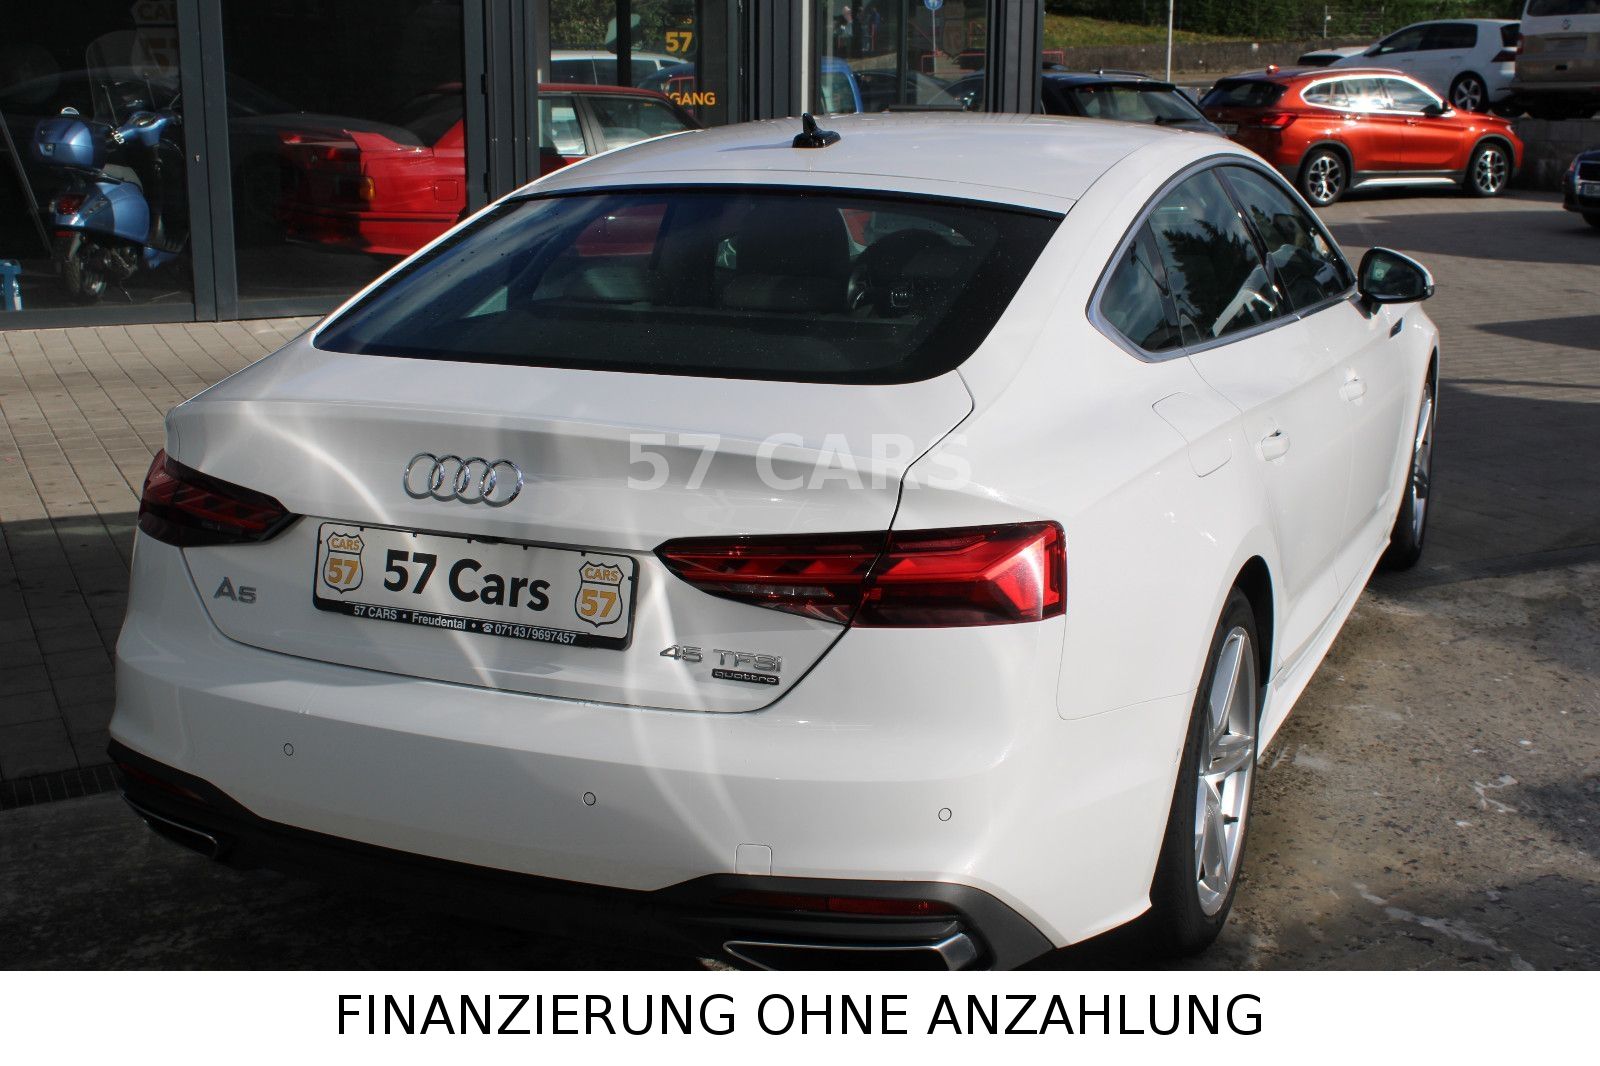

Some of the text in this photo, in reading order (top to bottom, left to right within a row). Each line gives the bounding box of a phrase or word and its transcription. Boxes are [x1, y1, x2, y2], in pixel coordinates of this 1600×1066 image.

[665, 31, 693, 52] 57
[331, 538, 360, 551] CARS
[327, 557, 358, 585] 57
[384, 549, 551, 612] 57 Cars
[584, 567, 619, 582] CARS
[213, 576, 257, 604] A5
[580, 588, 617, 618] 57
[354, 605, 366, 616] 57
[368, 607, 398, 620] CARS
[412, 612, 466, 630] Freudental
[659, 644, 703, 663] 45
[714, 670, 777, 683] quattro
